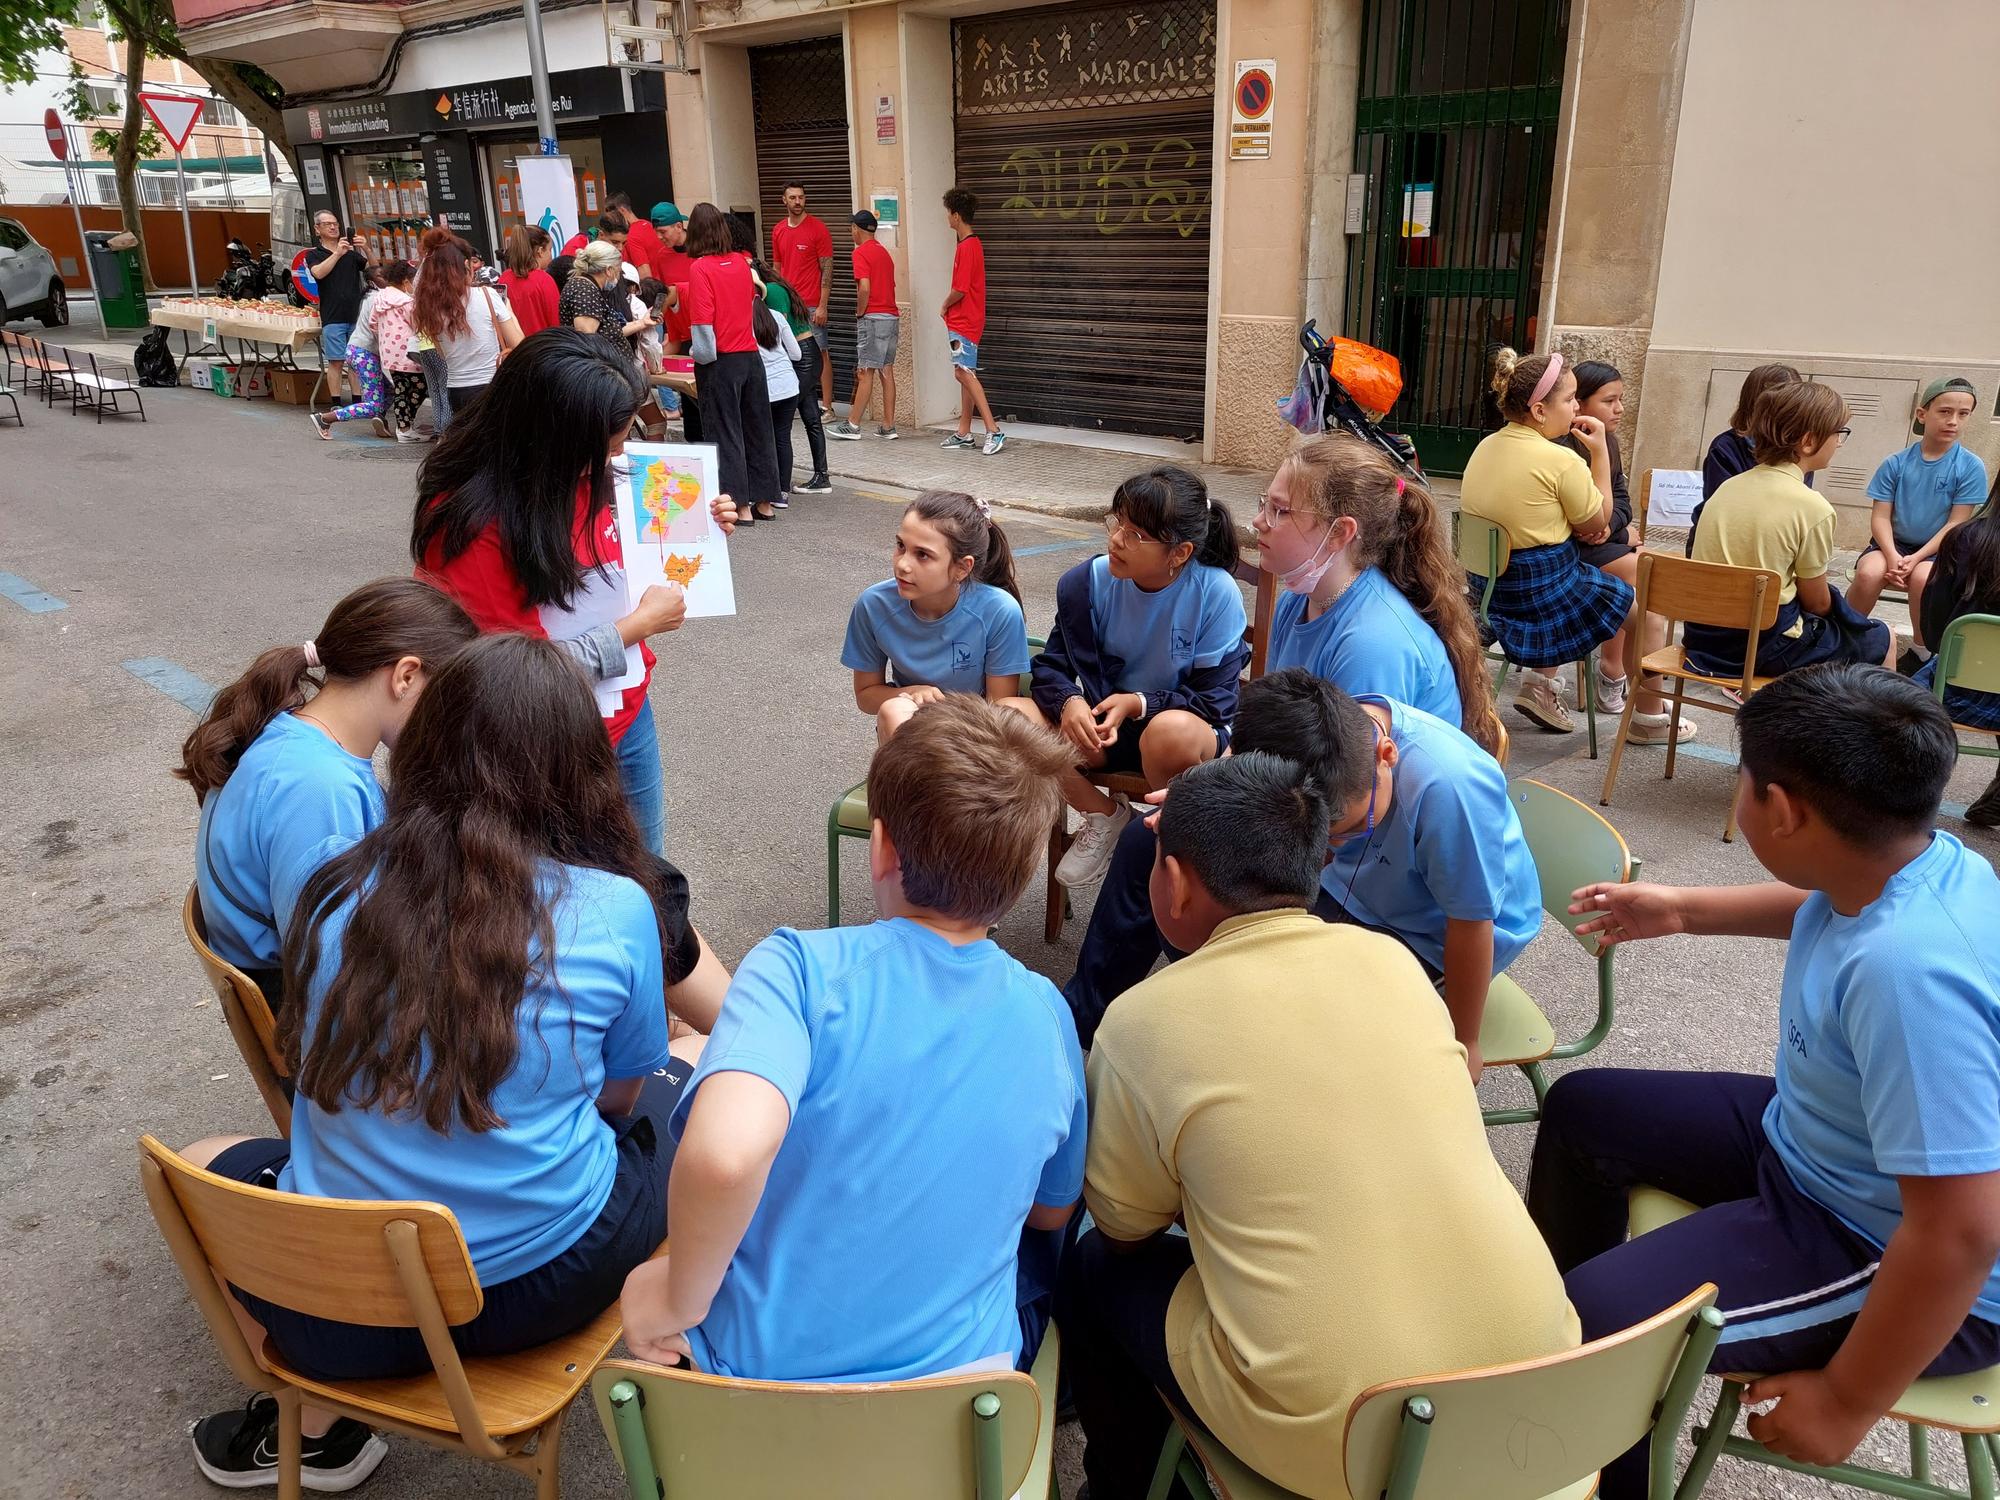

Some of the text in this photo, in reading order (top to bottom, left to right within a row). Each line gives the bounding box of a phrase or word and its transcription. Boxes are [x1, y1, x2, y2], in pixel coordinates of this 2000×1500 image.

[981, 68, 1048, 98] ARTES
[504, 100, 530, 120] Agencia
[530, 98, 537, 114] d
[560, 96, 573, 111] Rui
[328, 120, 363, 135] Inmobiliaria
[363, 117, 390, 133] Huading
[1245, 124, 1270, 132] PERMANENT
